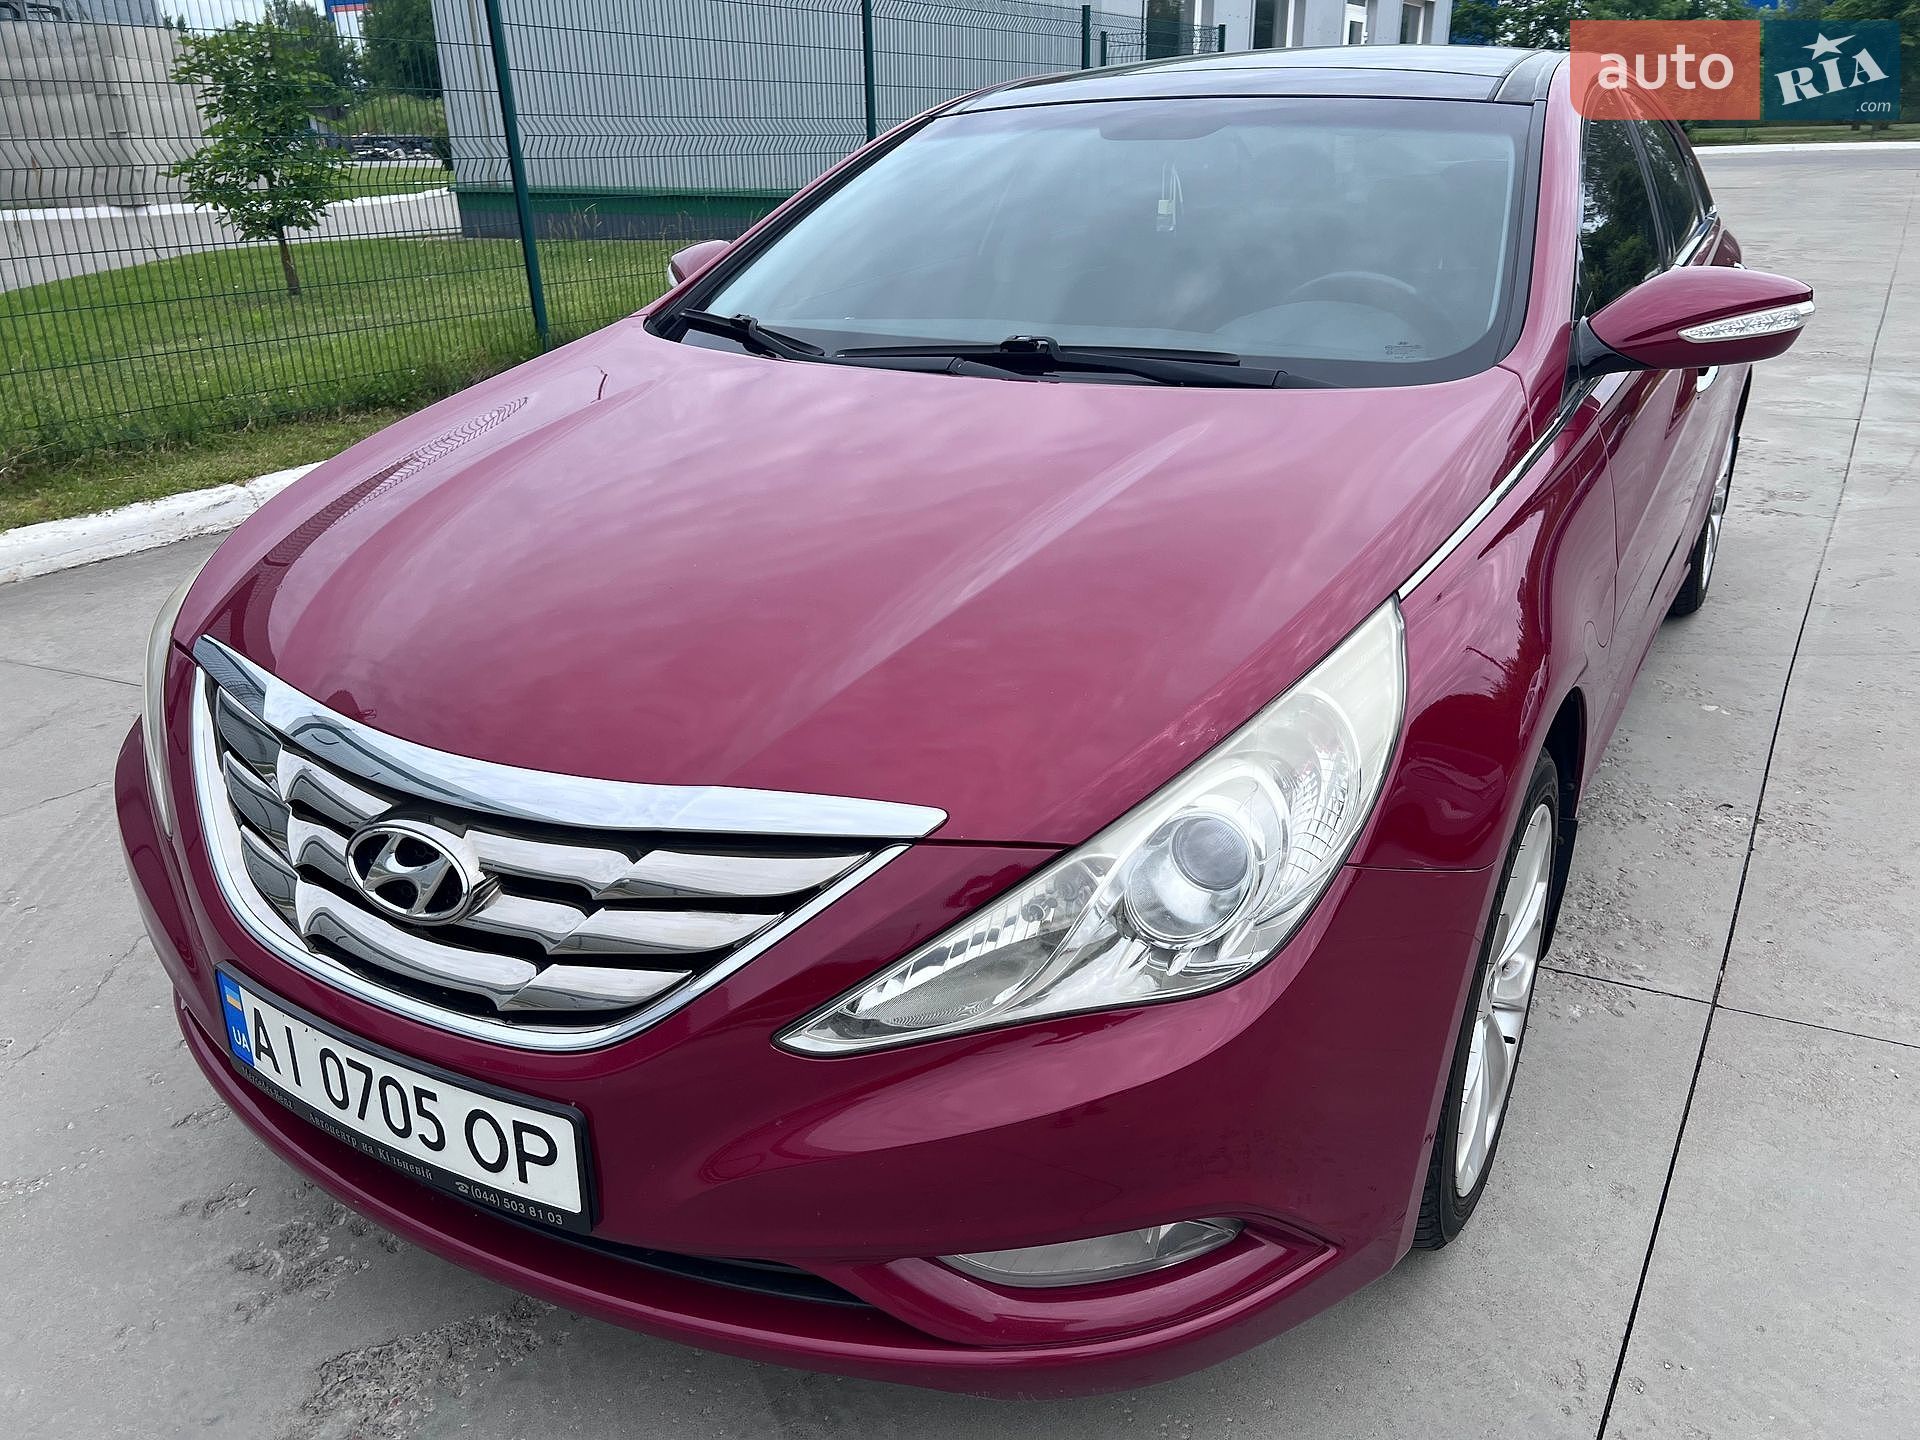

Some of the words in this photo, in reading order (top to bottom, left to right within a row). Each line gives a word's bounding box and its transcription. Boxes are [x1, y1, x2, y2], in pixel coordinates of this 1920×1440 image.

[232, 1026, 251, 1053] UA
[253, 1007, 302, 1087] AI
[319, 1047, 446, 1152] 0705
[464, 1108, 558, 1184] OP
[361, 1142, 374, 1155] на
[470, 1185, 500, 1207] (044)
[503, 1198, 526, 1214] 503
[529, 1206, 543, 1219] 81
[547, 1212, 563, 1225] 03
